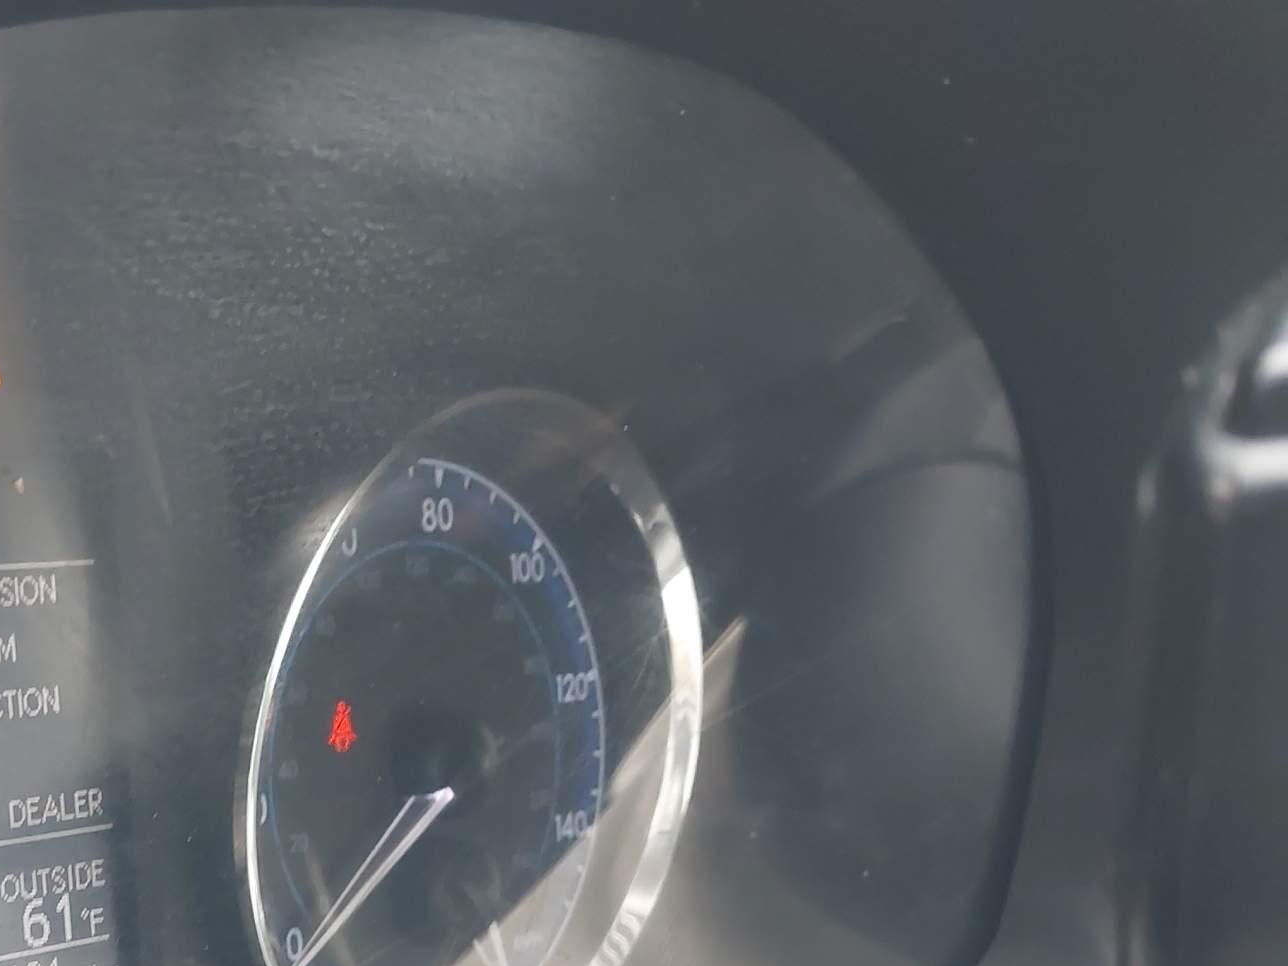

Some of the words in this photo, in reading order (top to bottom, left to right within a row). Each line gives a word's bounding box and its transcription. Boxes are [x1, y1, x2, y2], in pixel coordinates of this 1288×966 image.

[421, 497, 454, 533] 80
[509, 552, 545, 584] 100
[556, 672, 588, 704] 120
[8, 787, 104, 829] DEALER
[554, 813, 589, 843] 140
[0, 857, 107, 904] OUTSIDE
[285, 926, 304, 961] 0
